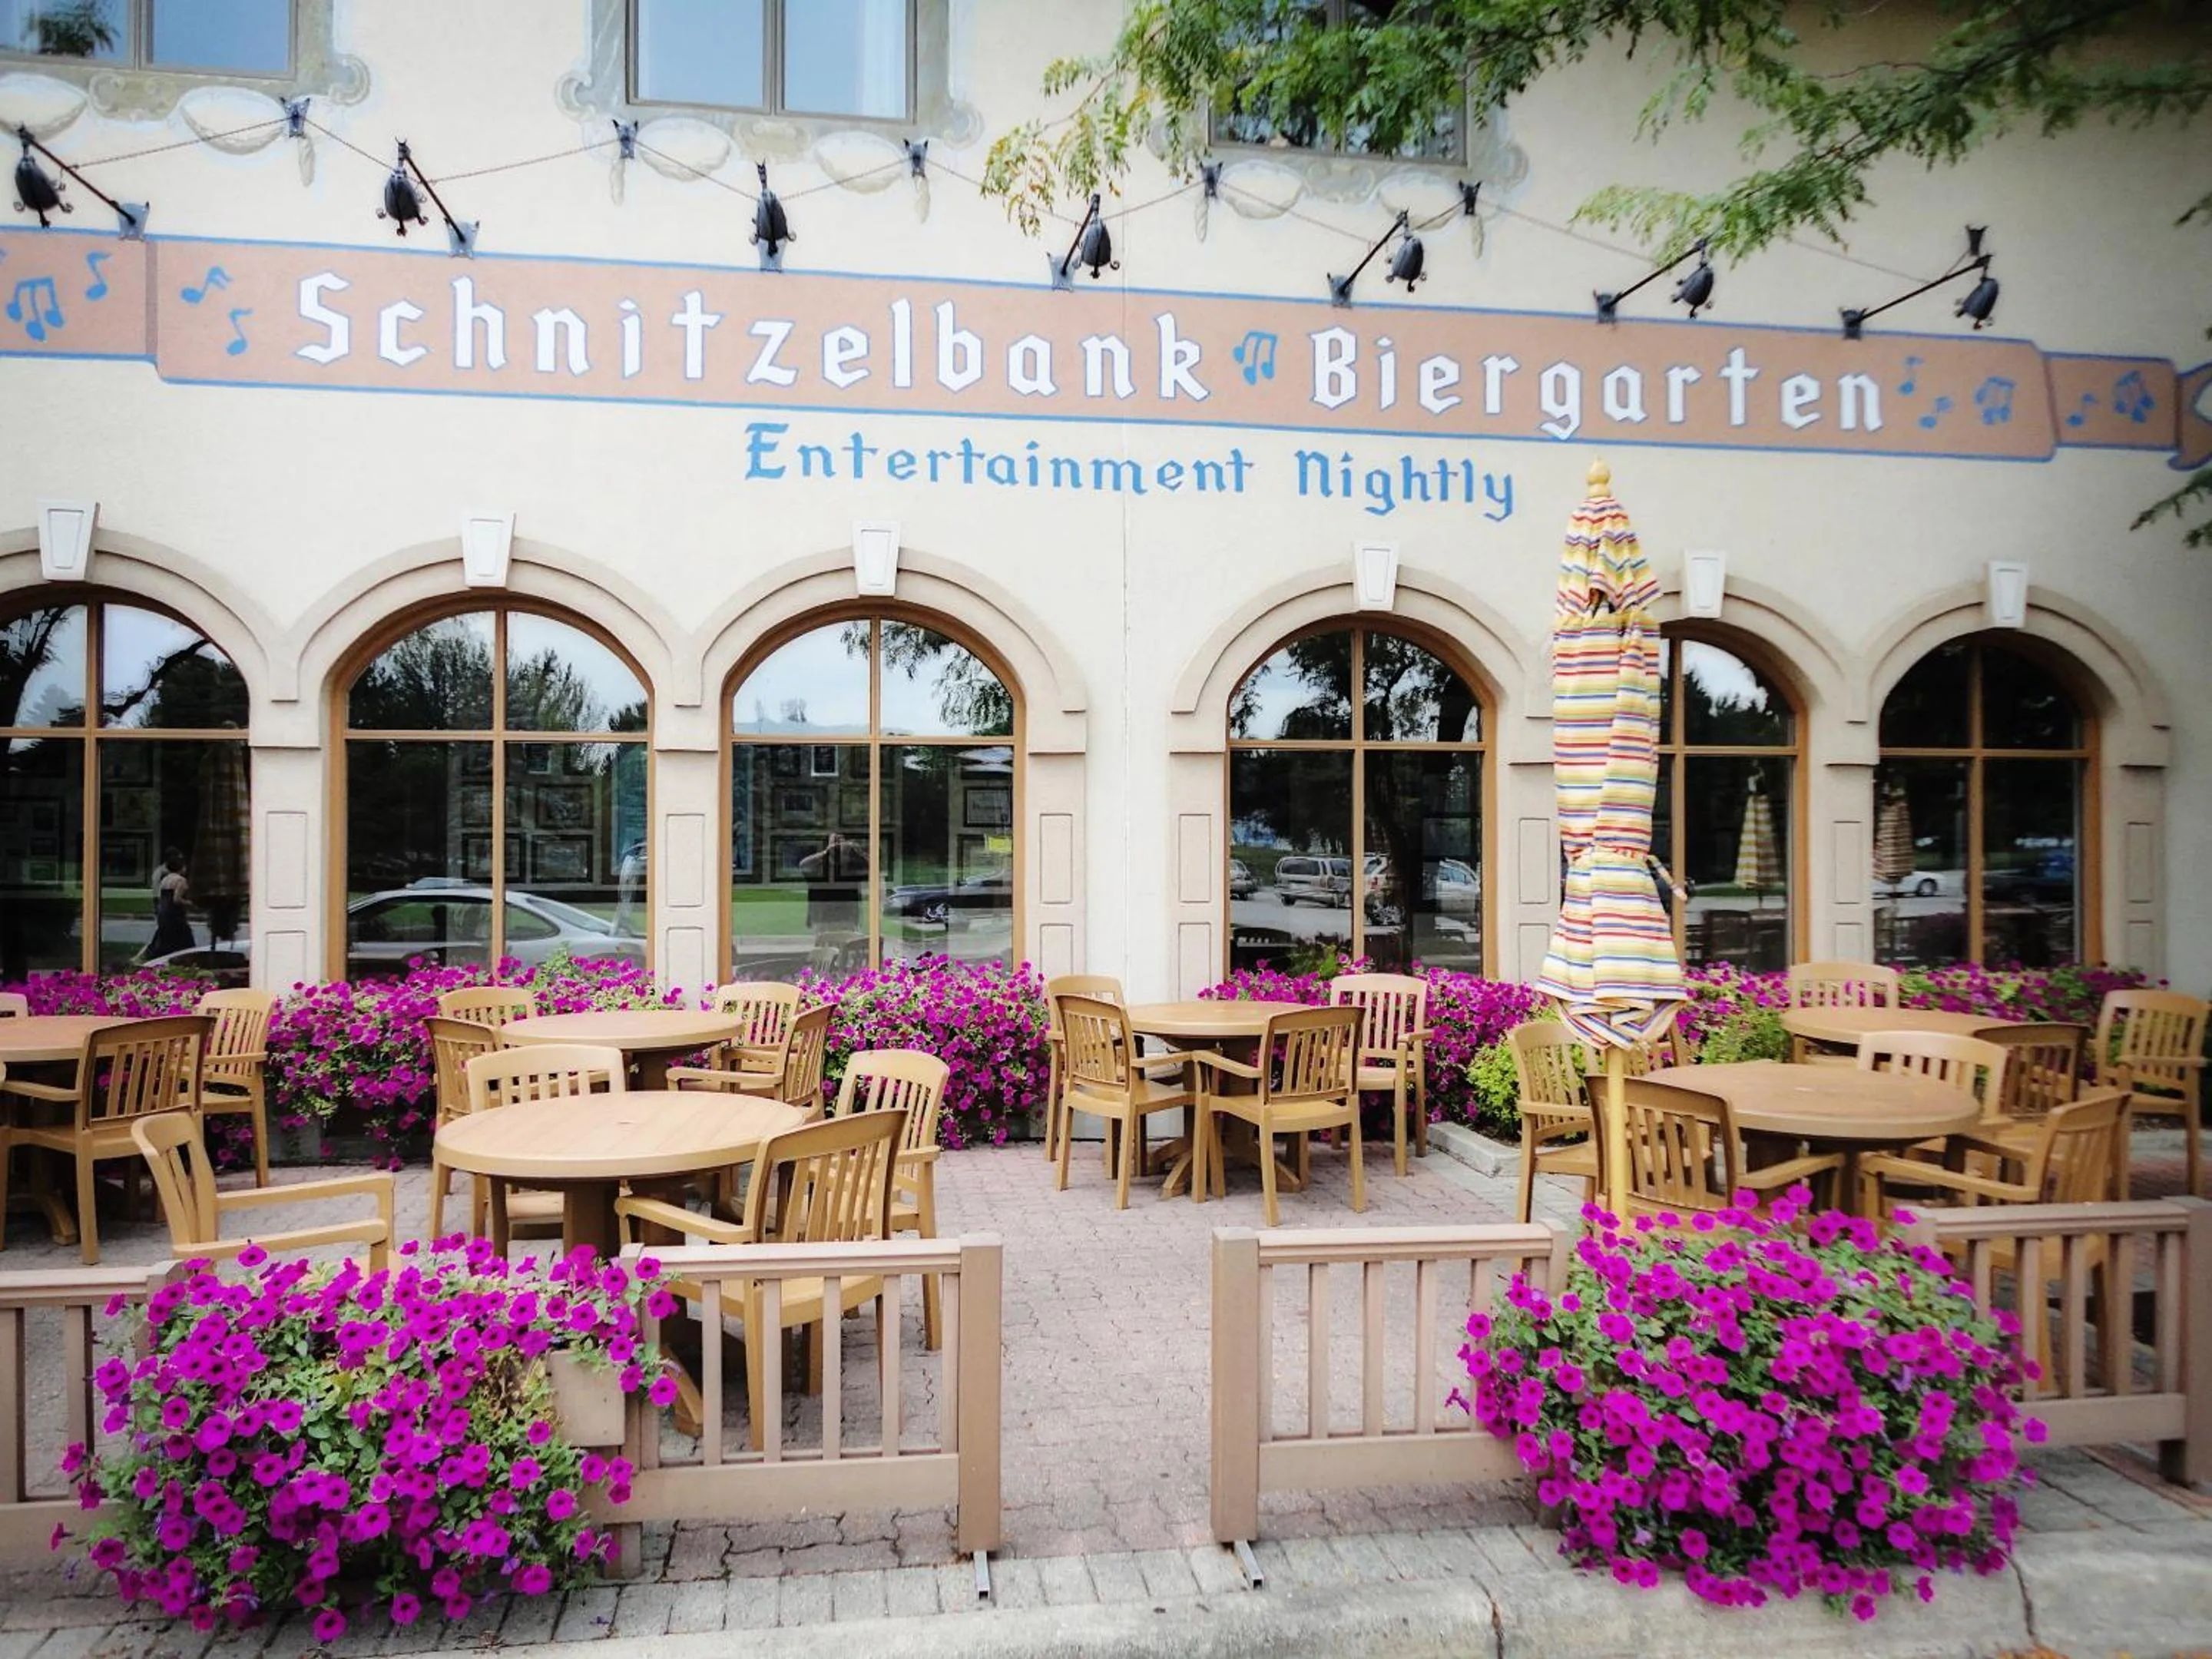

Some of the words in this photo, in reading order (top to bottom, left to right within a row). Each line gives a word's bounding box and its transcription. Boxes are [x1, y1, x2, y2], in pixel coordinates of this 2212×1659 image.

[295, 271, 1210, 402] Schnitzelbank
[1310, 326, 1883, 441] Biergarten
[745, 422, 1253, 495] Entertainment
[1296, 449, 1515, 522] Nightly
